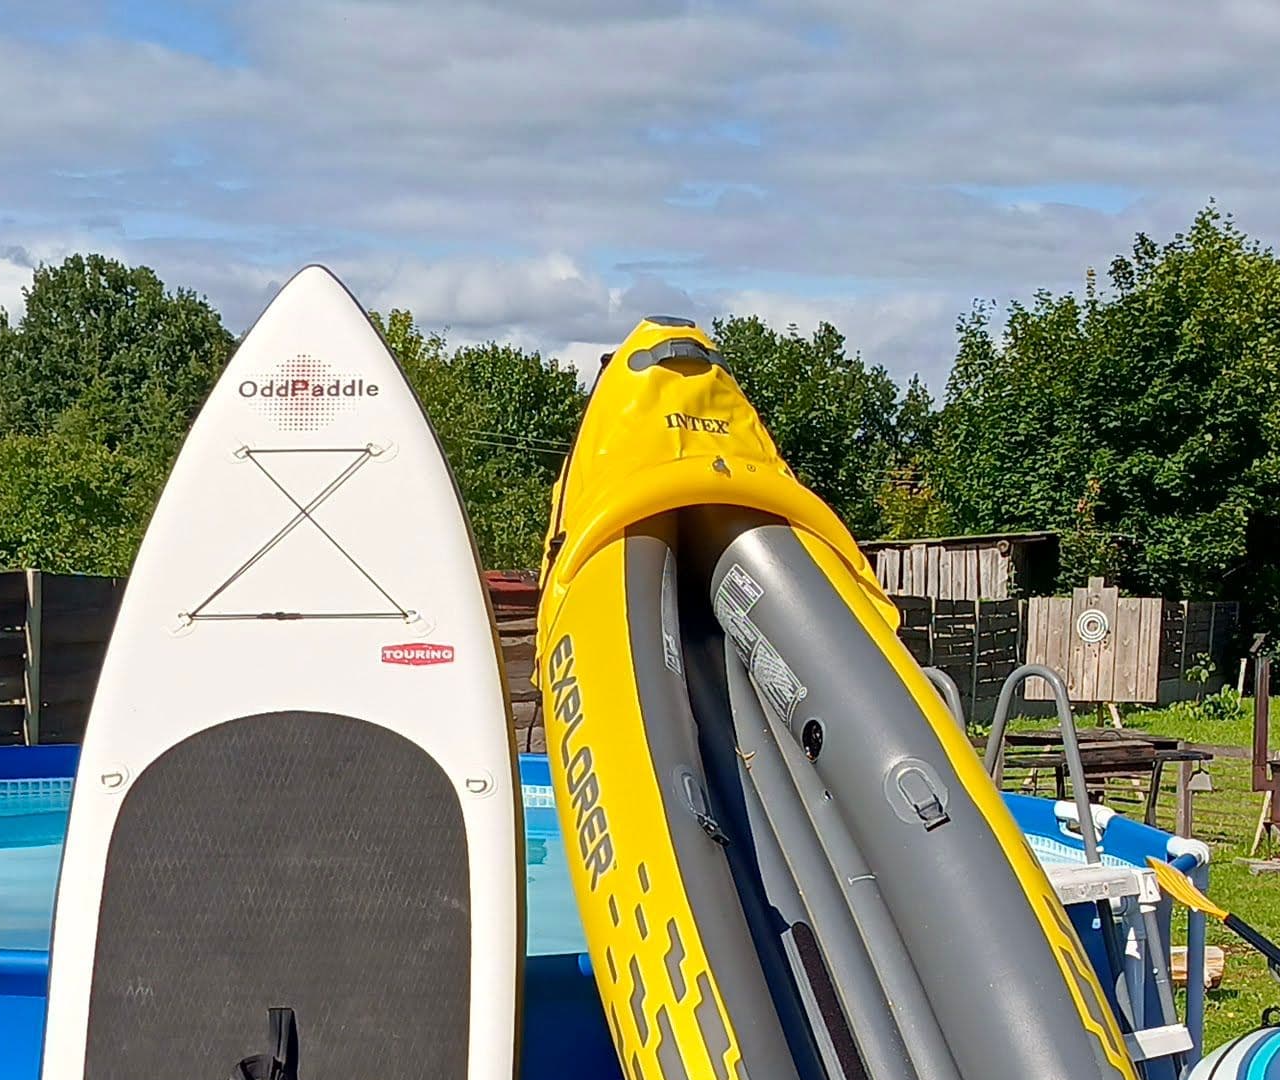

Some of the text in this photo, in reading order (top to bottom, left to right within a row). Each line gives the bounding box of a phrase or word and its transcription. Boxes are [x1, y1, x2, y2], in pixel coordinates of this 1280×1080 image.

[238, 379, 379, 398] OddPaddle
[665, 413, 729, 434] INTEX
[383, 649, 453, 660] TOURING
[549, 634, 615, 893] EXPLORER
